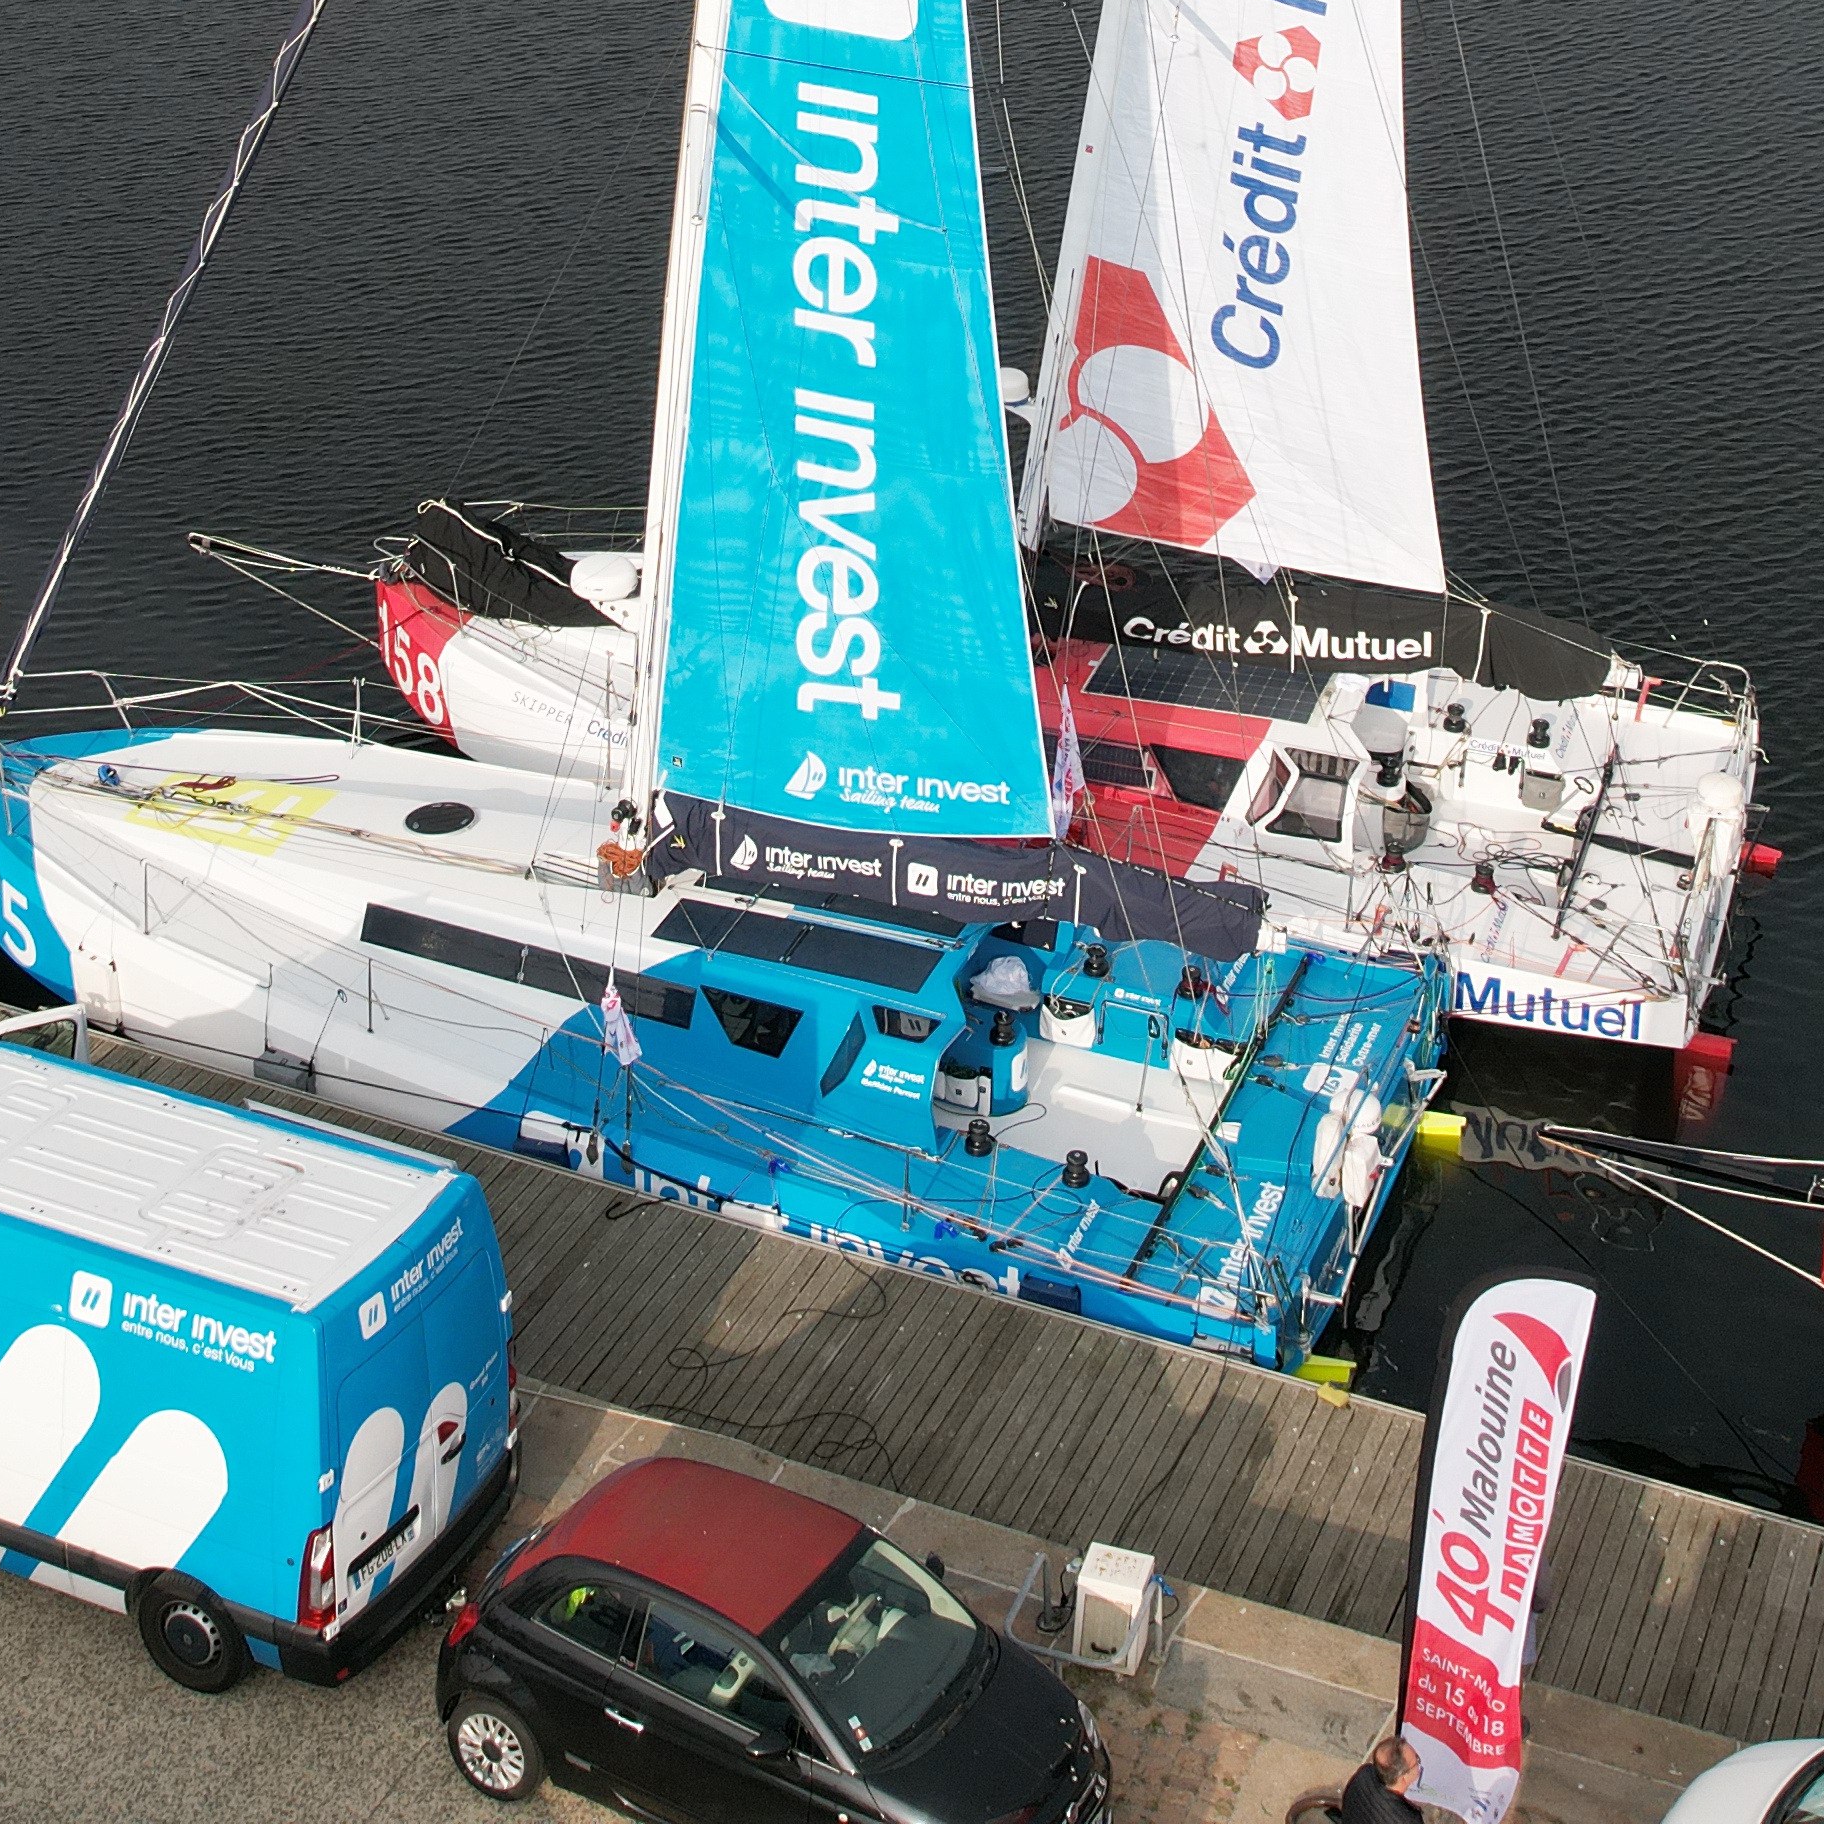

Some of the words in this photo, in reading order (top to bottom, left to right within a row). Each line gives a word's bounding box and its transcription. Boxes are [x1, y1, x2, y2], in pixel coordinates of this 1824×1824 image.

[791, 80, 900, 370] inter
[1209, 120, 1309, 371] Crédit
[794, 389, 901, 721] invest
[378, 599, 444, 725] 158
[1122, 616, 1241, 654] Crédit
[1294, 624, 1432, 661] Mutuel
[511, 690, 574, 727] SKIPPER
[838, 765, 909, 796] inter
[916, 775, 1011, 806] invest
[765, 845, 812, 870] inter
[817, 853, 882, 878] invest
[947, 873, 997, 897] inter
[1002, 877, 1066, 898] invest
[1454, 971, 1646, 1041] Mutuel
[390, 1259, 424, 1302] inter
[426, 1216, 464, 1269] invest
[121, 1320, 153, 1340] entre
[155, 1330, 189, 1353] nous,
[123, 1291, 187, 1332] inter
[191, 1313, 277, 1364] invest
[1460, 1339, 1517, 1539] Malouine
[1503, 1404, 1551, 1603] LAMOTTE
[1416, 1695, 1506, 1756] SEPTEMBRE
[1418, 1673, 1437, 1694] du
[1444, 1680, 1466, 1709] 15
[1482, 1713, 1506, 1737] 18
